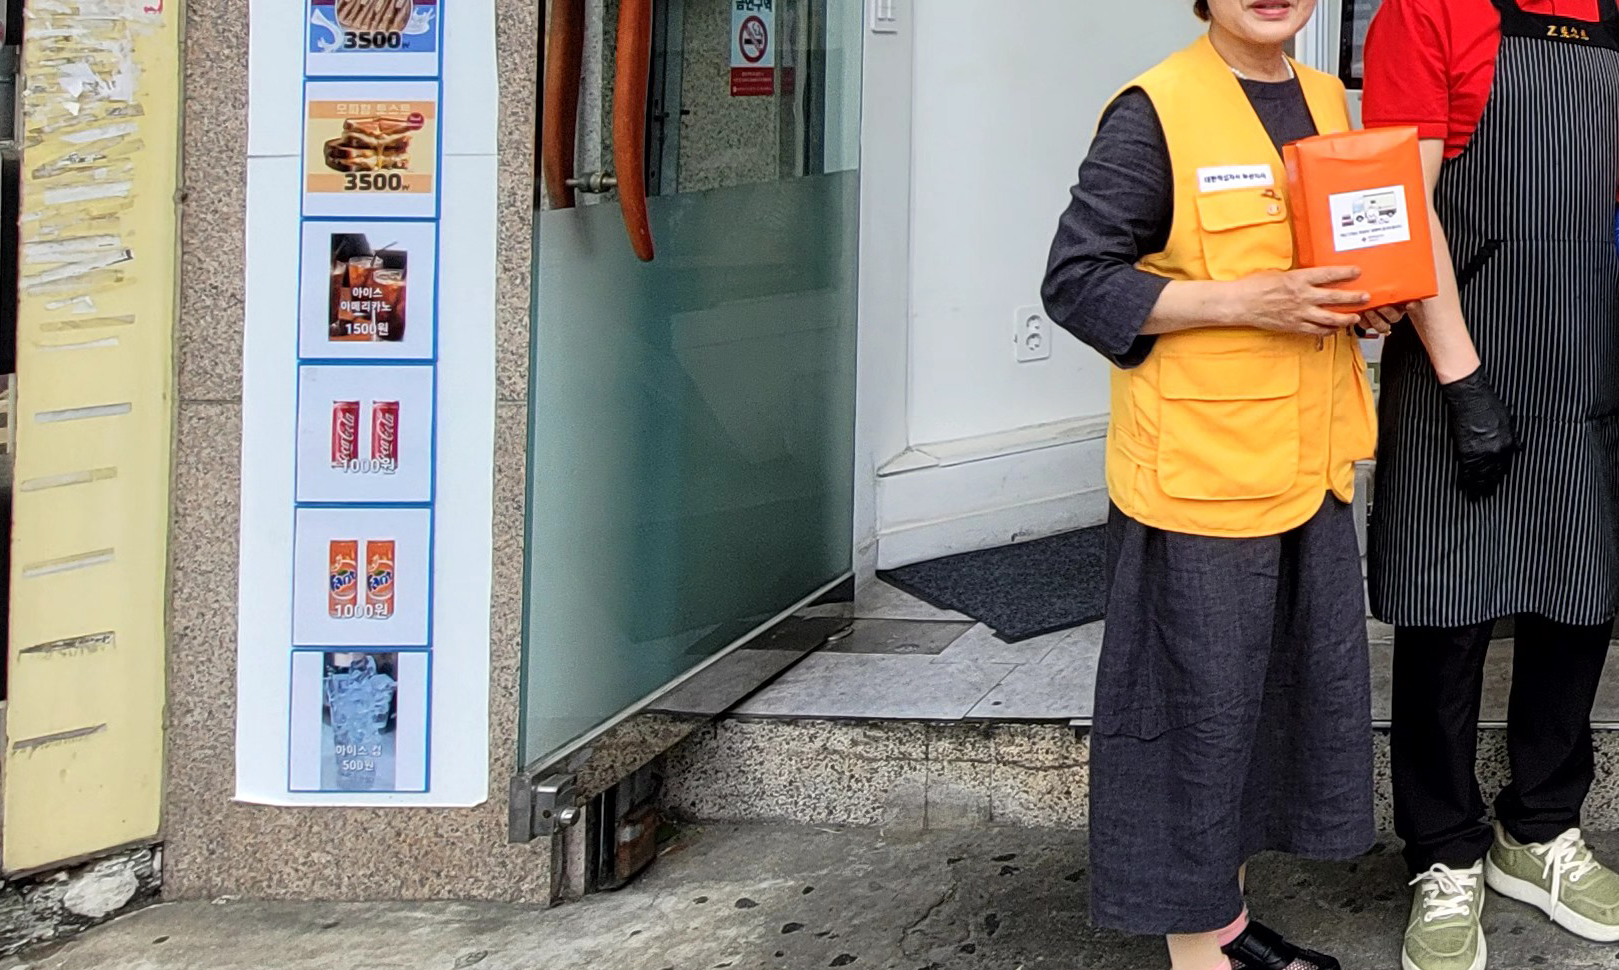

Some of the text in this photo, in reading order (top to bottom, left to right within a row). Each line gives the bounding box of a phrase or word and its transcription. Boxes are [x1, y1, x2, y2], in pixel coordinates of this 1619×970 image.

[343, 31, 401, 50] 3500
[344, 172, 401, 191] 3500
[352, 286, 384, 299] 아이스
[340, 300, 393, 312] 아메리카노
[344, 322, 390, 337] 1500원
[342, 458, 397, 475] 1000원
[334, 601, 389, 619] 1000원
[335, 744, 367, 756] 아이스
[341, 759, 375, 772] 500원
